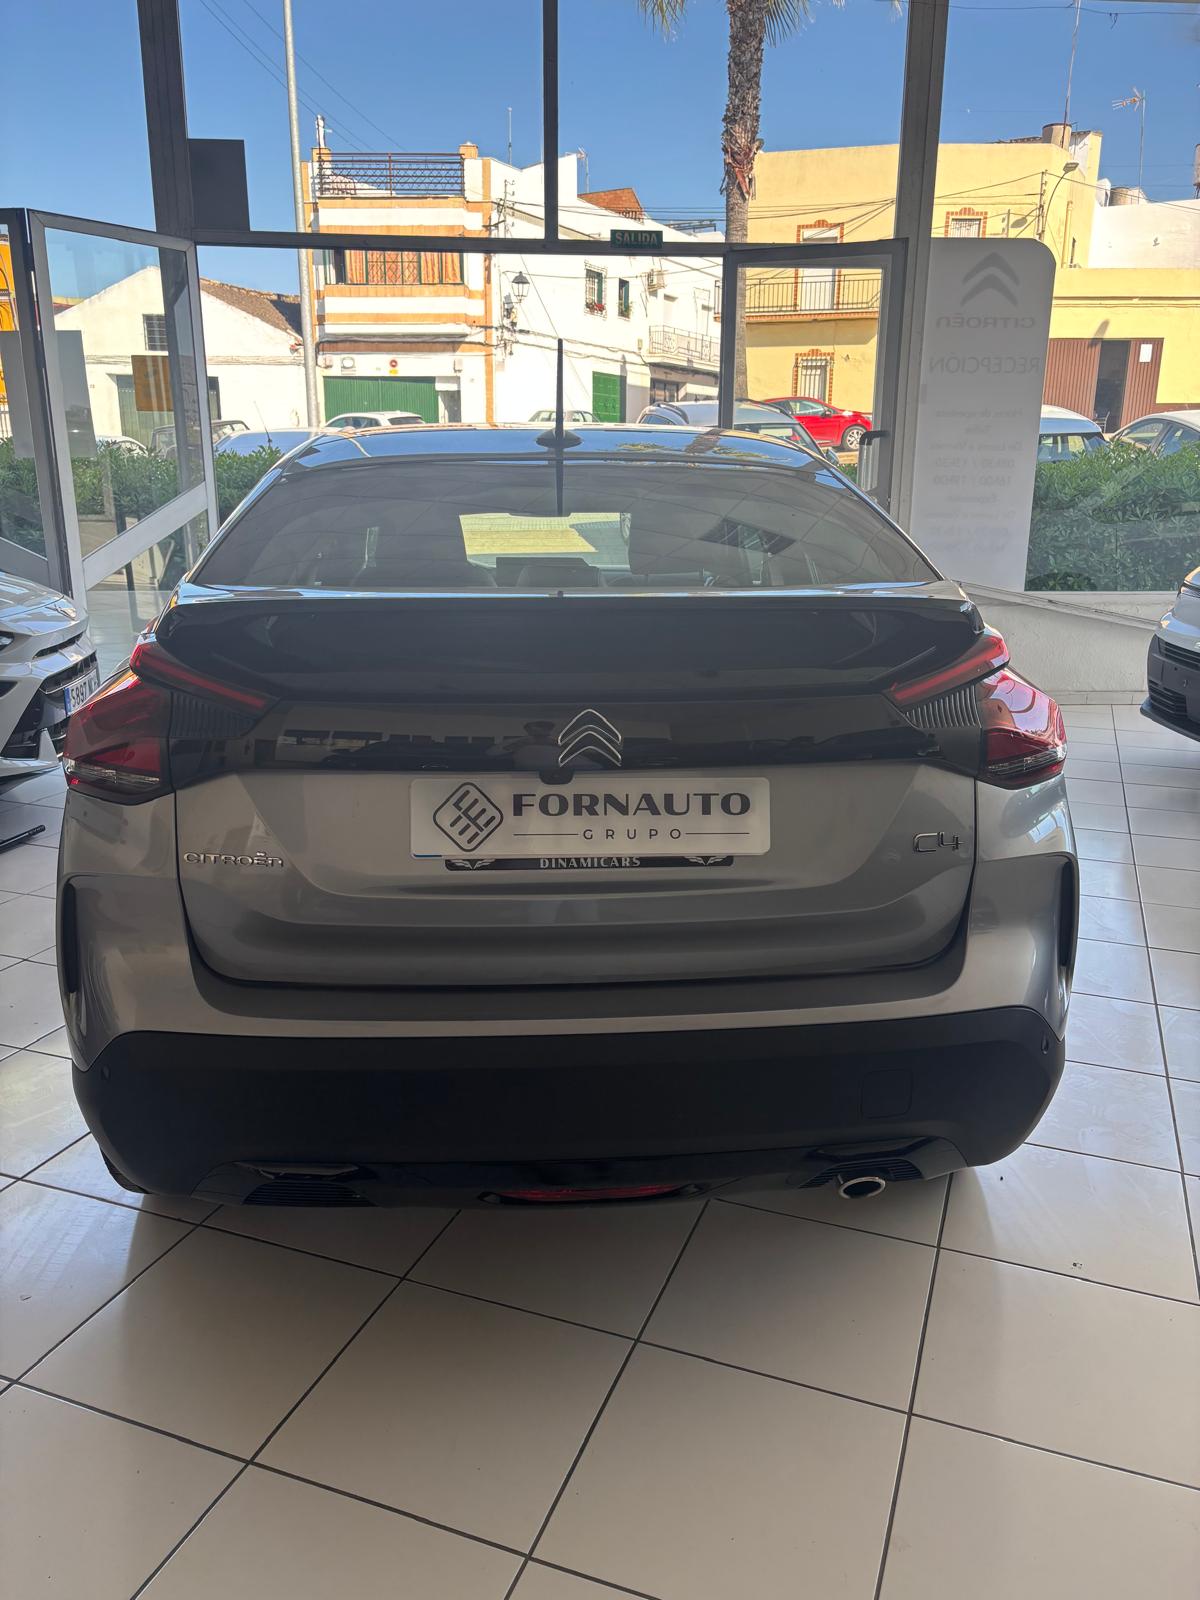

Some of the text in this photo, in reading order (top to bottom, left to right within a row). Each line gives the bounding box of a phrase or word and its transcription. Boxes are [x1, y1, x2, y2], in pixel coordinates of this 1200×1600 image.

[615, 231, 658, 244] SALIDA
[512, 791, 751, 817] FORNAUTO
[582, 827, 682, 840] GRUPO
[912, 832, 964, 853] C4
[539, 856, 641, 869] DINAMICARS
